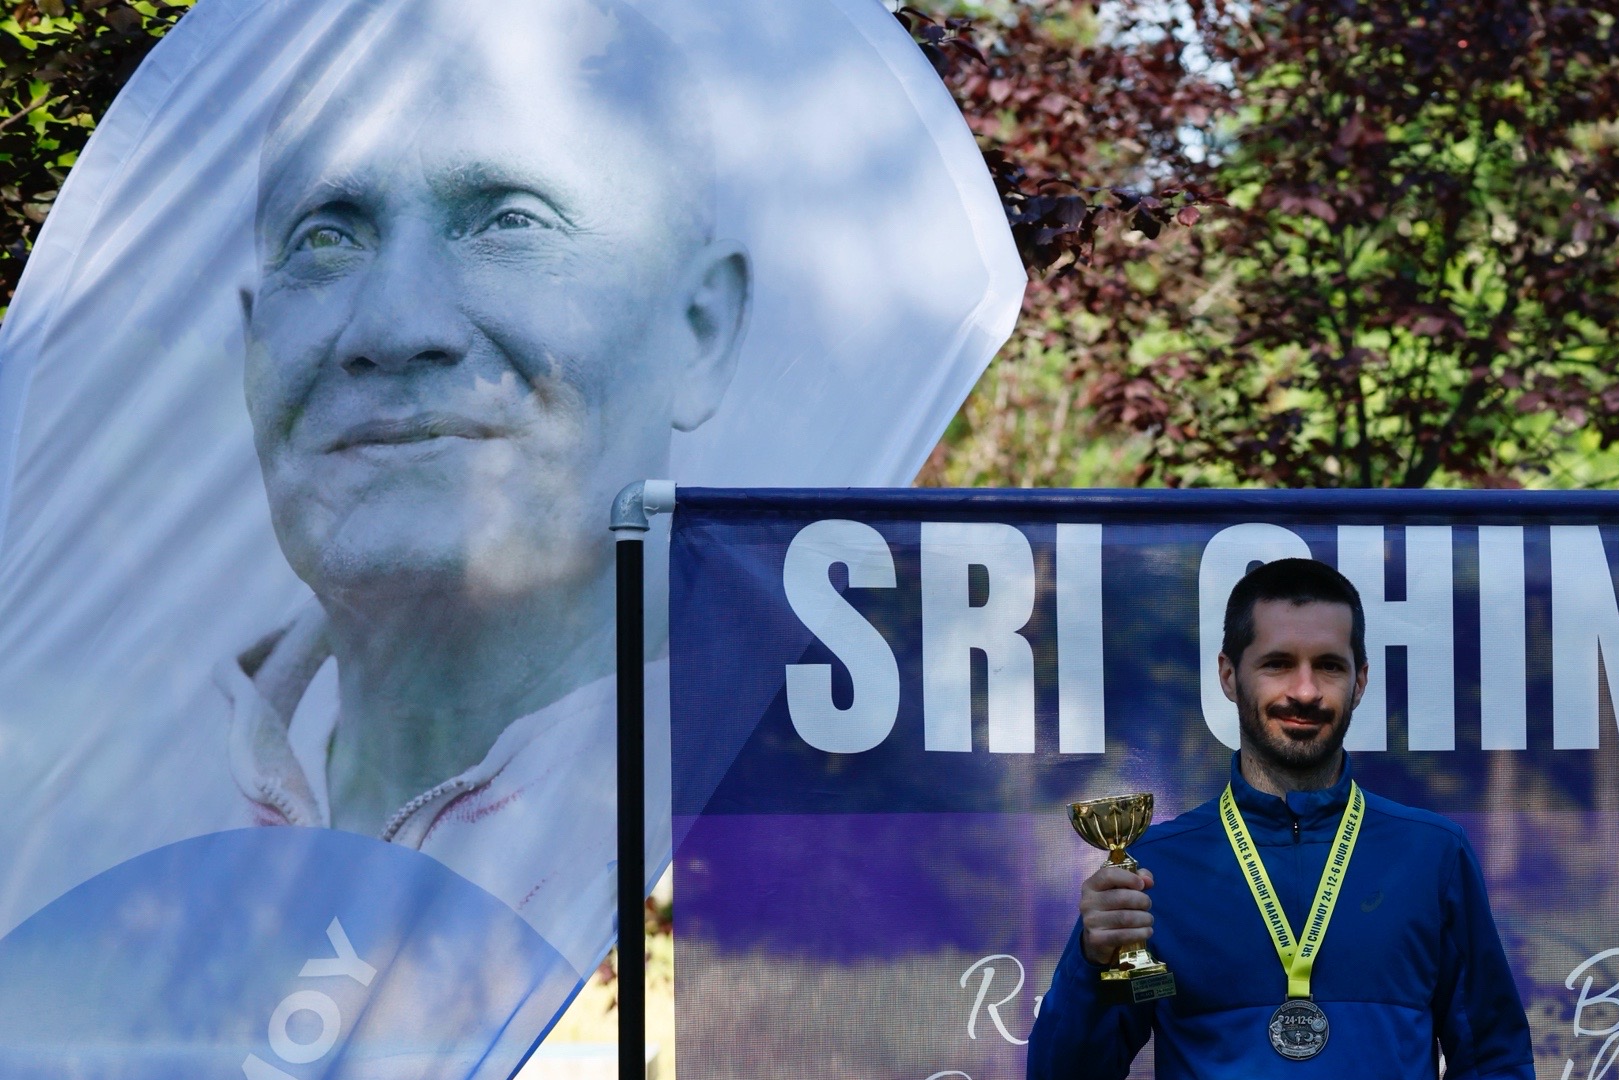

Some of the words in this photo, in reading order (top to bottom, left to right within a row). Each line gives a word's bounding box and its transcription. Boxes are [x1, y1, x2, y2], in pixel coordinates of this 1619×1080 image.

[783, 518, 1106, 754] SRI
[1350, 813, 1359, 821] &
[1342, 820, 1356, 845] RACE
[1334, 842, 1349, 867] HOUR
[1225, 807, 1240, 831] HOUR
[1233, 830, 1249, 854] RACE
[1246, 860, 1271, 901] MIDNIGHT
[1264, 900, 1291, 948] MARATHON
[1321, 867, 1341, 902] 24-12-6
[1307, 903, 1329, 942] CHINMOY
[1301, 941, 1315, 958] SRI
